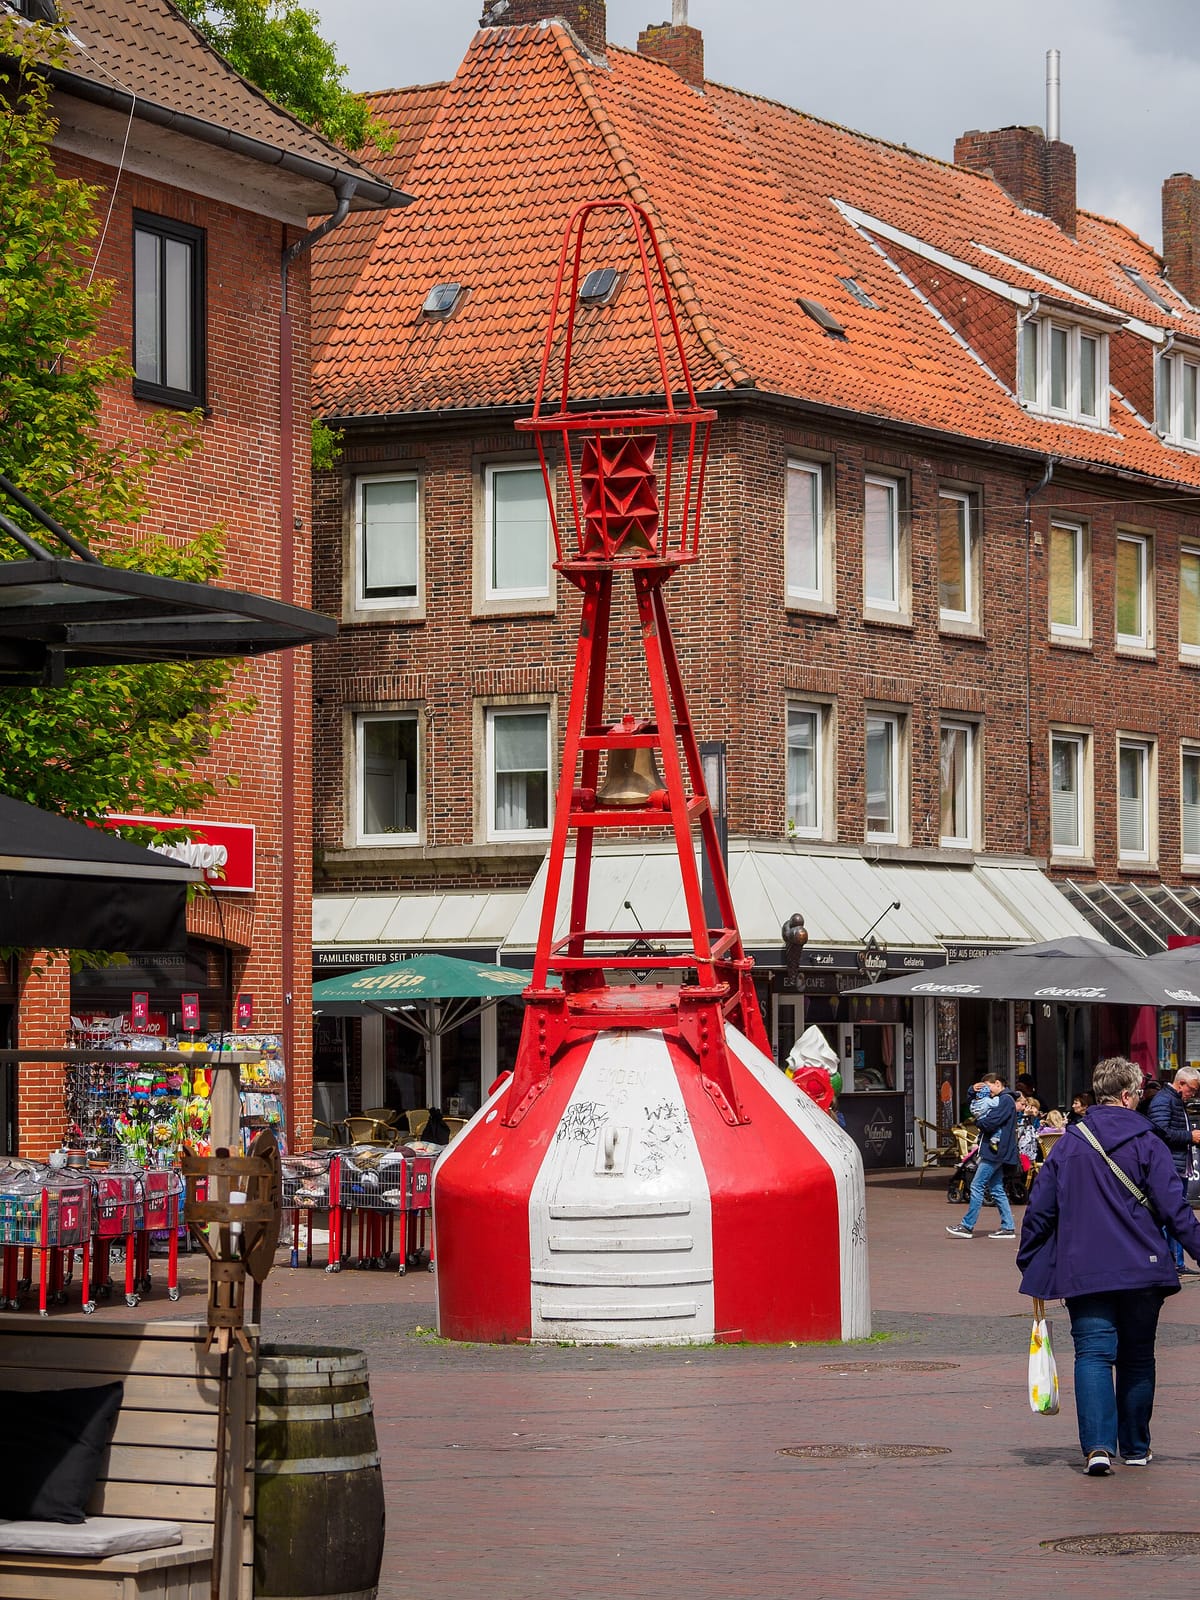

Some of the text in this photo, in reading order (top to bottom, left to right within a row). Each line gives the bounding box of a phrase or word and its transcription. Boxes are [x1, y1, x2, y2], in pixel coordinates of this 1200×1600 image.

[319, 953, 387, 963] FAMILIENBETRIEB
[389, 953, 407, 962] SEIT
[958, 950, 967, 958] AUS
[903, 957, 925, 967] Gelateria
[352, 974, 426, 989] JEVER
[1042, 1003, 1051, 1019] 10
